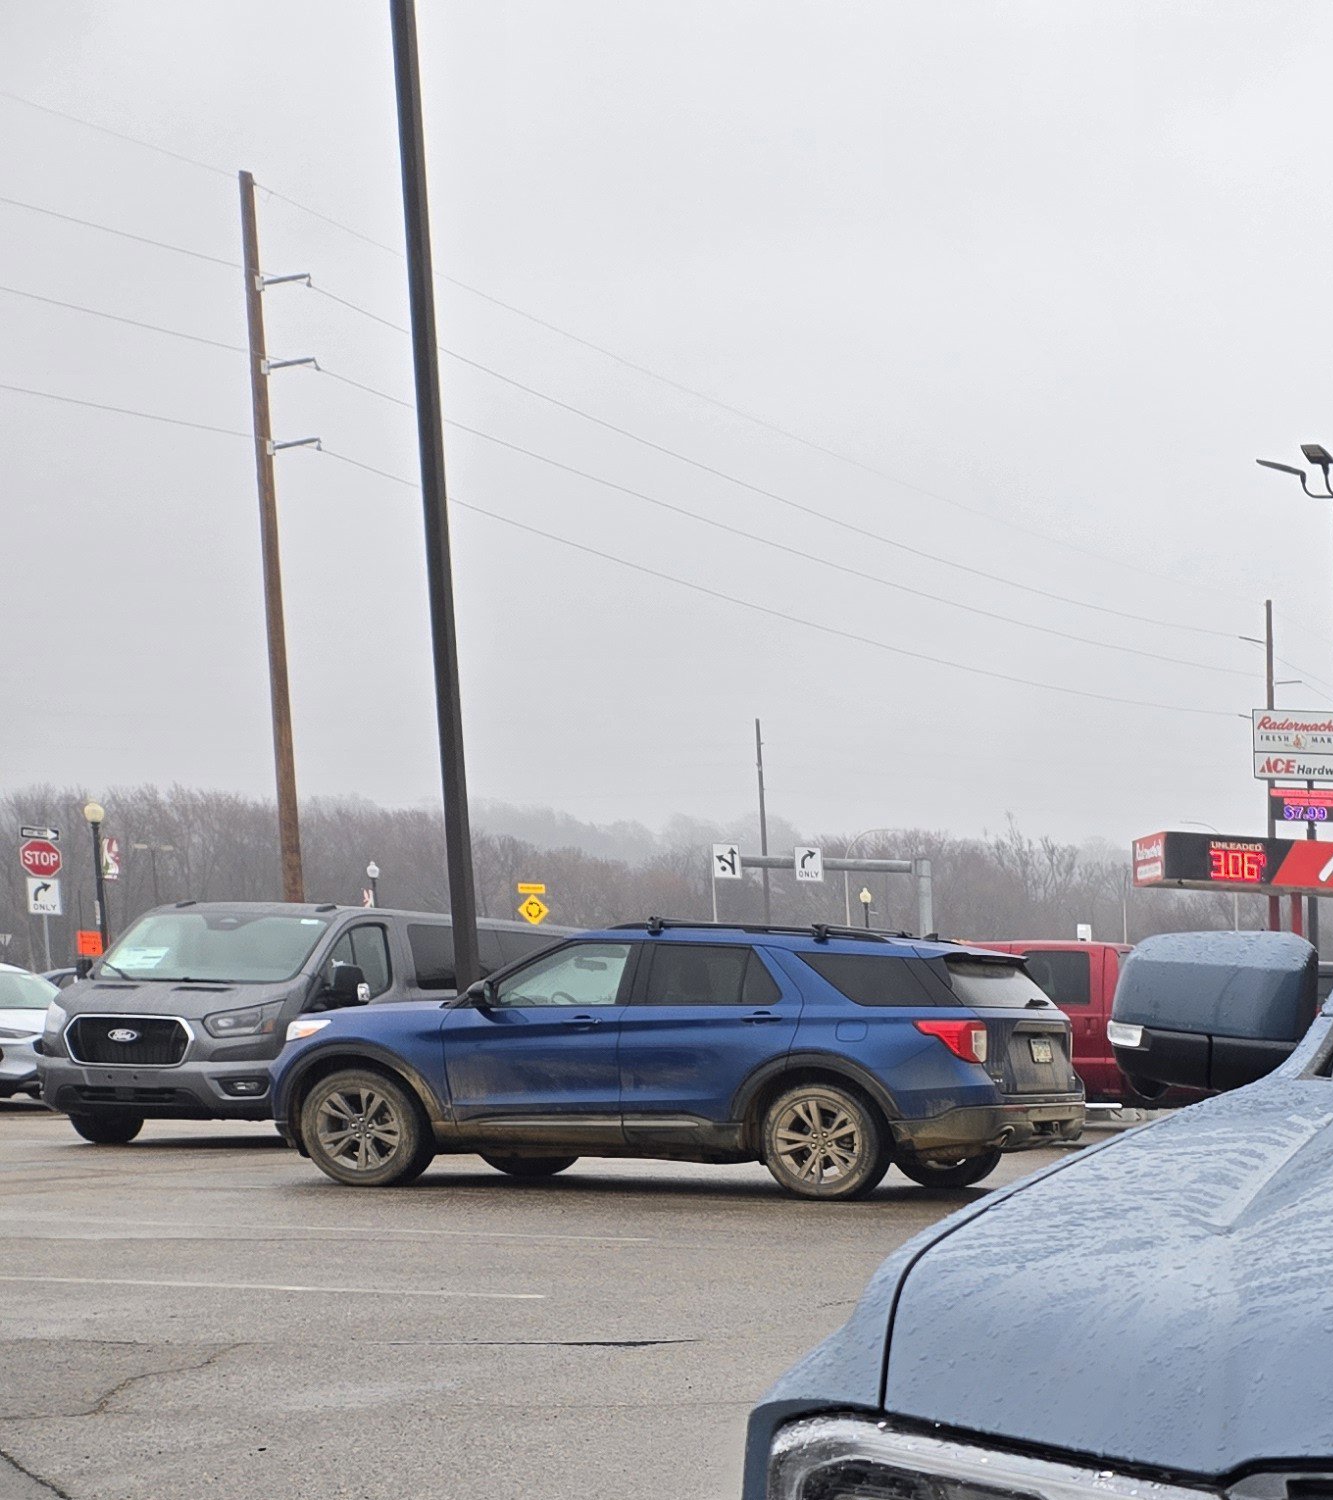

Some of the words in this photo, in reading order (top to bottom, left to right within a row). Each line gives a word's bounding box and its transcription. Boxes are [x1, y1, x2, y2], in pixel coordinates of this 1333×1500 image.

[1259, 757, 1296, 774] ACE
[1283, 806, 1328, 820] $7.99
[1210, 841, 1262, 851] UNLEADED
[24, 851, 59, 866] STOP
[799, 870, 820, 878] ONLY
[33, 903, 57, 911] ONLY
